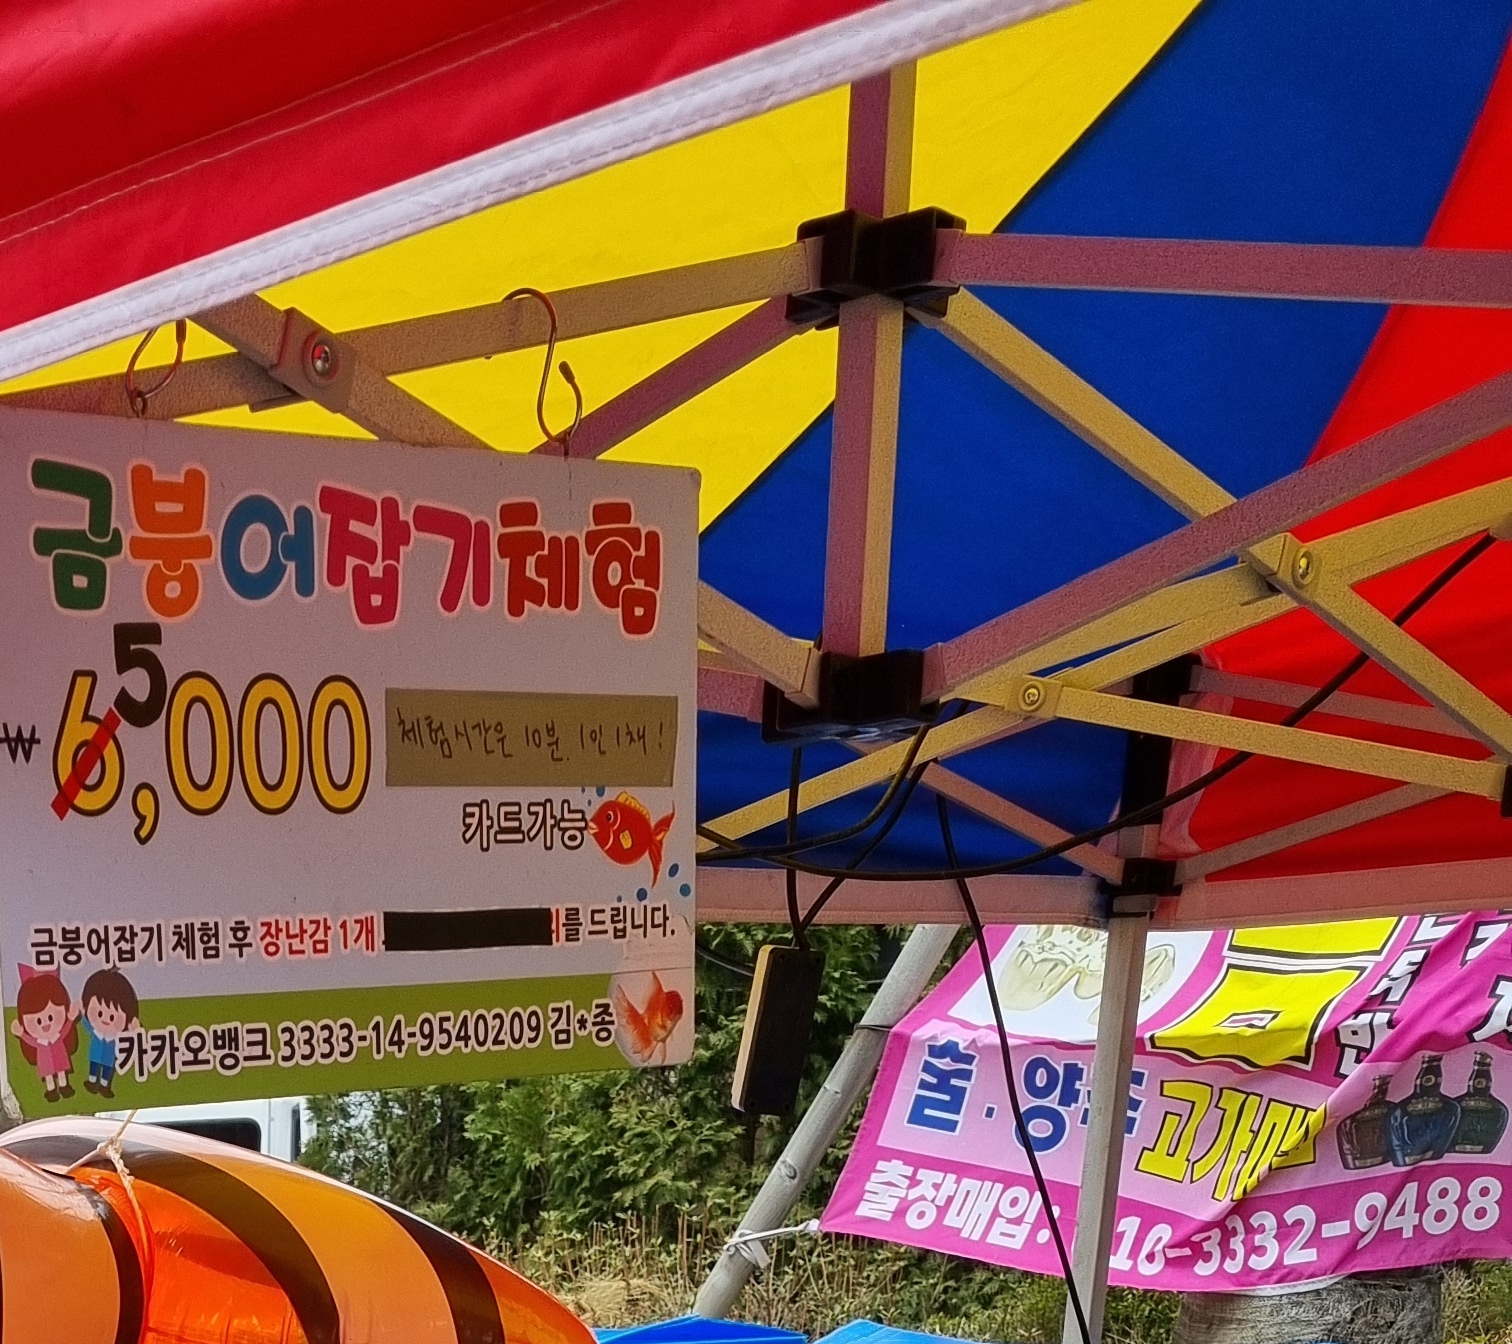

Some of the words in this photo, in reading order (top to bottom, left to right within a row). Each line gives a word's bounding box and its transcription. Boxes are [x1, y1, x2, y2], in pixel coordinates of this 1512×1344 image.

[30, 457, 663, 636] 금붕어잡기체험
[461, 799, 588, 852] 카드가능
[30, 923, 165, 967] 금붕어잡기
[171, 921, 221, 960] 체험
[227, 919, 253, 958] 후
[259, 917, 330, 957] 장난감
[337, 914, 376, 953] 1개
[587, 903, 677, 940] 드립니다.
[118, 1026, 273, 1079] 카카오뱅크
[279, 1009, 542, 1065] 3333-14-9540209
[1071, 1176, 1501, 1278] 10-3332-9488
